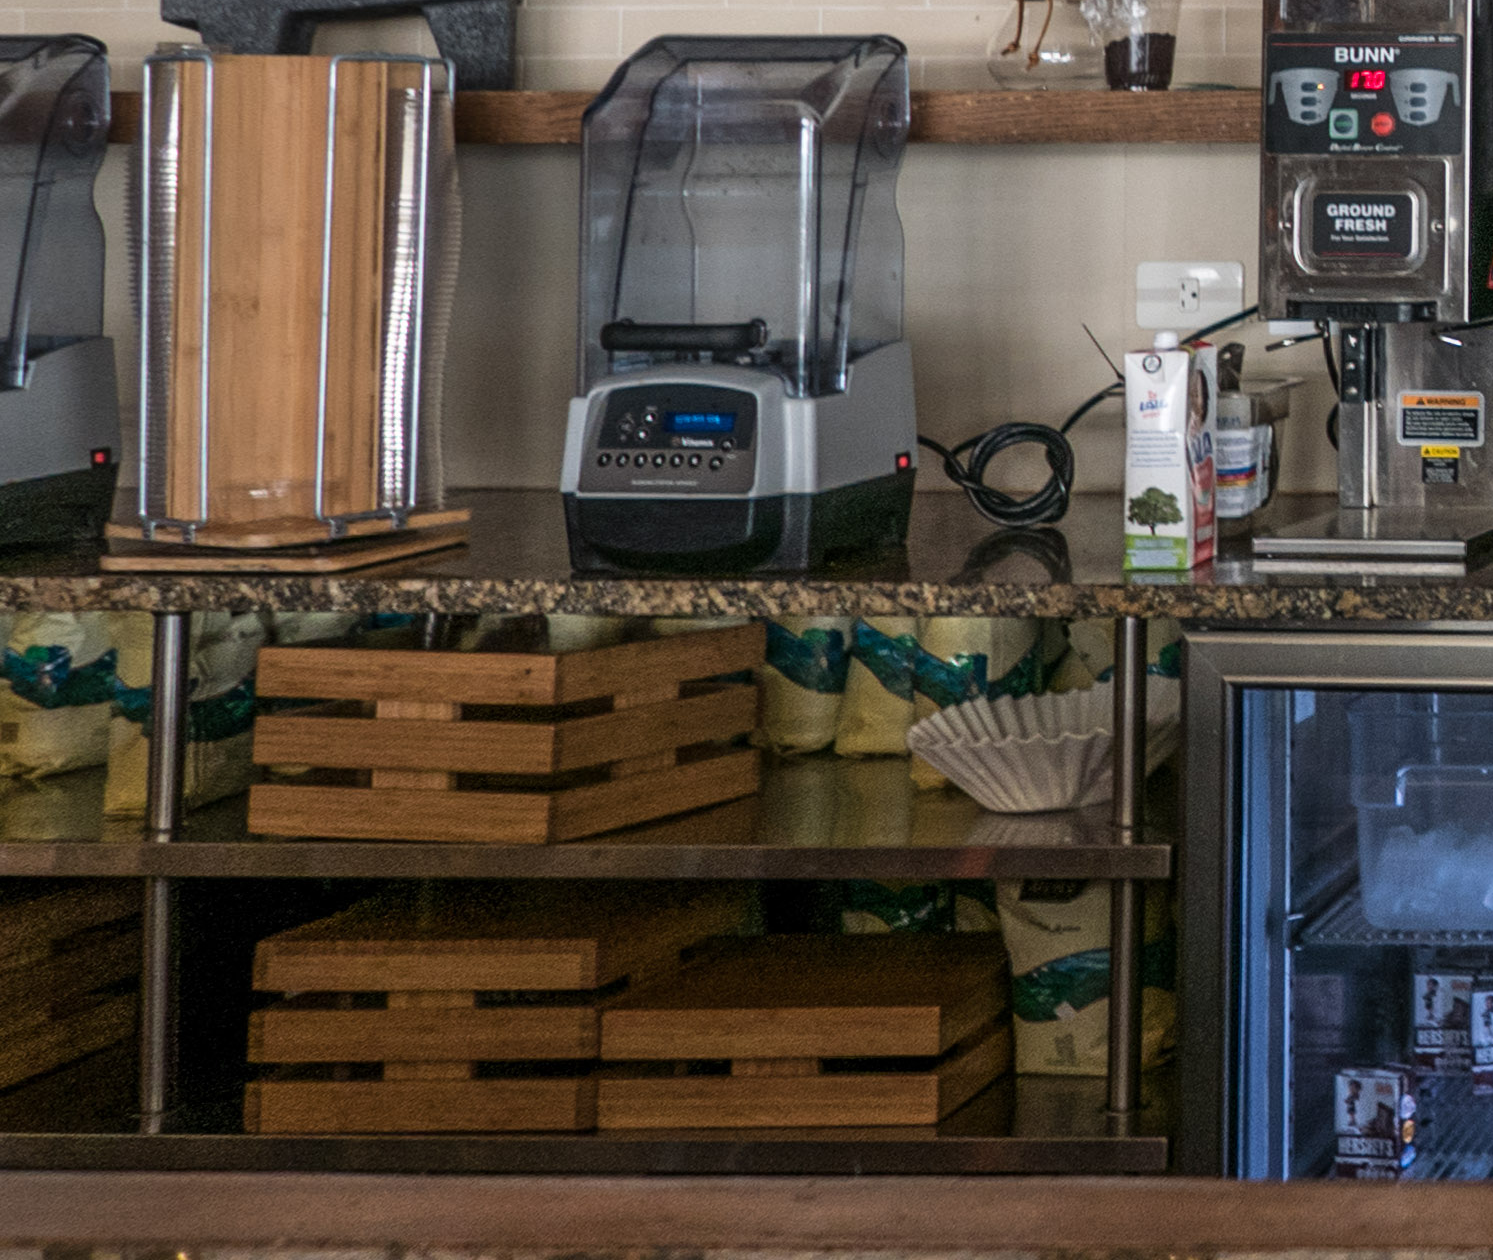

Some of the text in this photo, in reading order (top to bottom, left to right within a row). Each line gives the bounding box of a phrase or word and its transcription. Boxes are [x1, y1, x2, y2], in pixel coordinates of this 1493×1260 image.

[1335, 47, 1395, 63] BUNN
[1327, 203, 1396, 218] GROUND
[1335, 219, 1387, 232] FRESH
